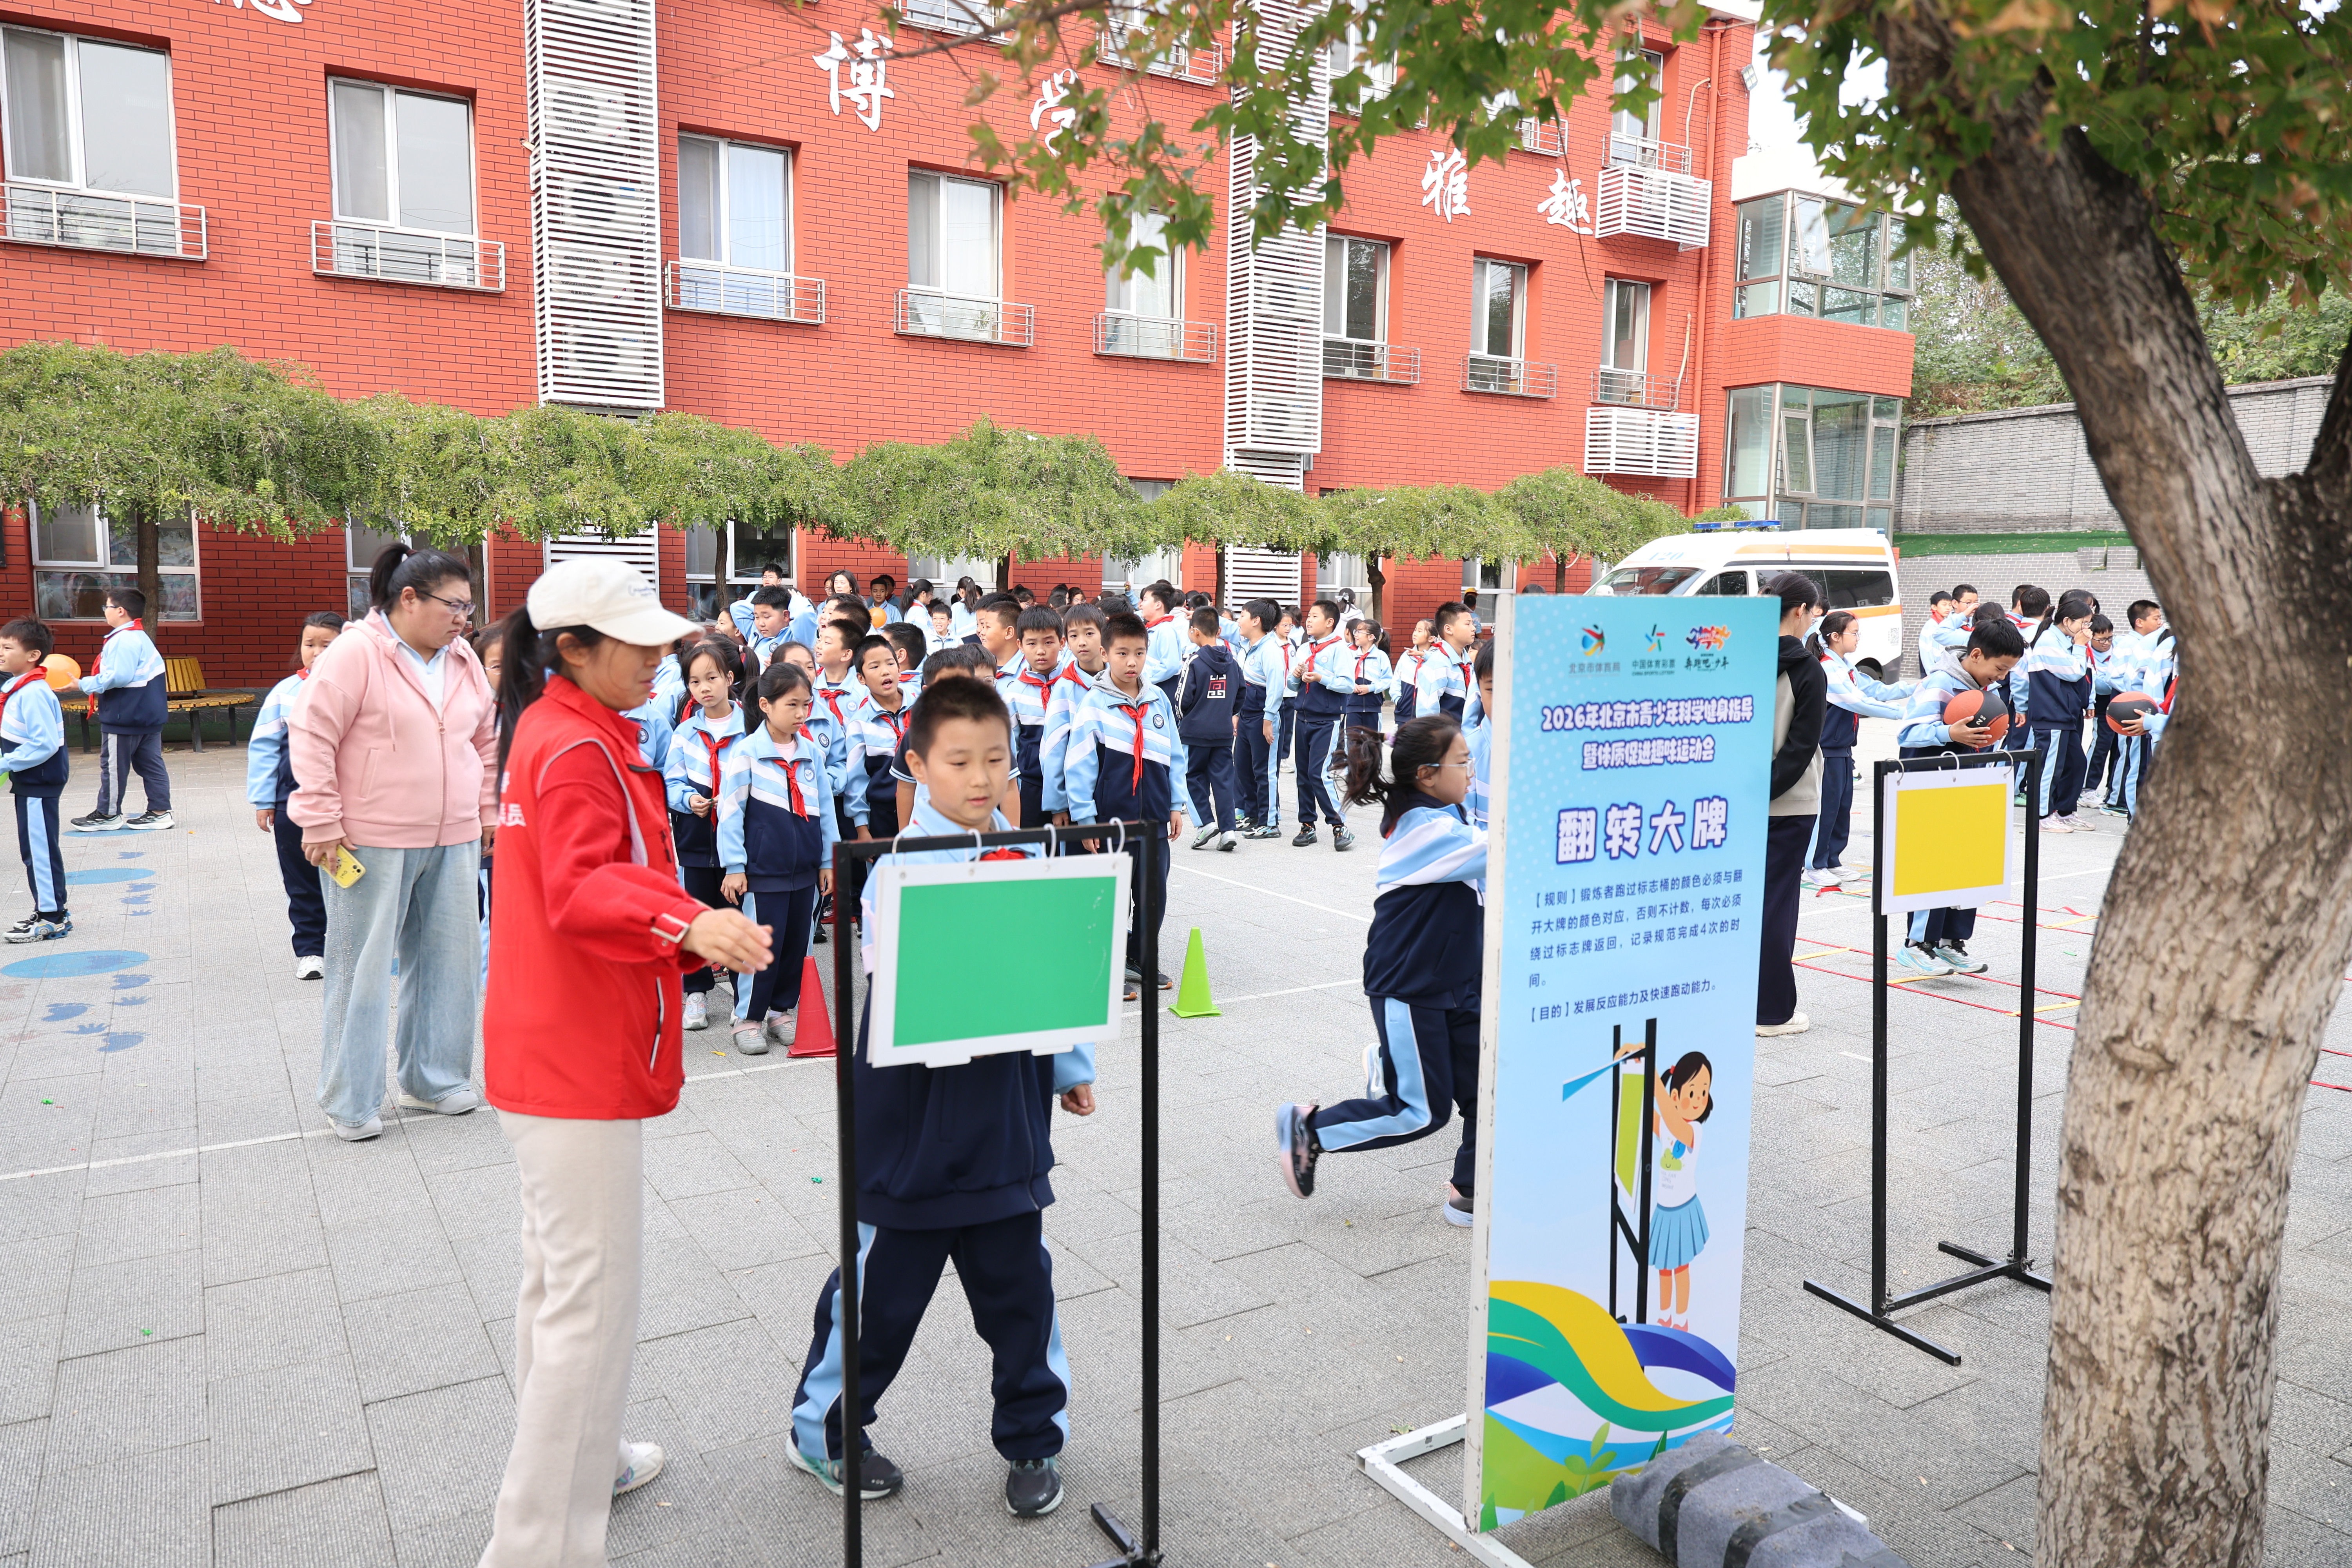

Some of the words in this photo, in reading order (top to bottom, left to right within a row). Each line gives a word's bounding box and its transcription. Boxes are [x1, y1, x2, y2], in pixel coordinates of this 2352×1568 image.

[812, 28, 895, 132] 博
[1421, 147, 1472, 223] 雅
[1537, 168, 1593, 235] 趣
[1632, 659, 1676, 670] 中国体育彩票
[1542, 695, 1753, 731] 2026年北京市青少年科学健身指导
[1582, 735, 1715, 770] 暨体质促进趣味运动会
[1556, 795, 1728, 864] 翻转大牌
[1529, 973, 1546, 988] 间。
